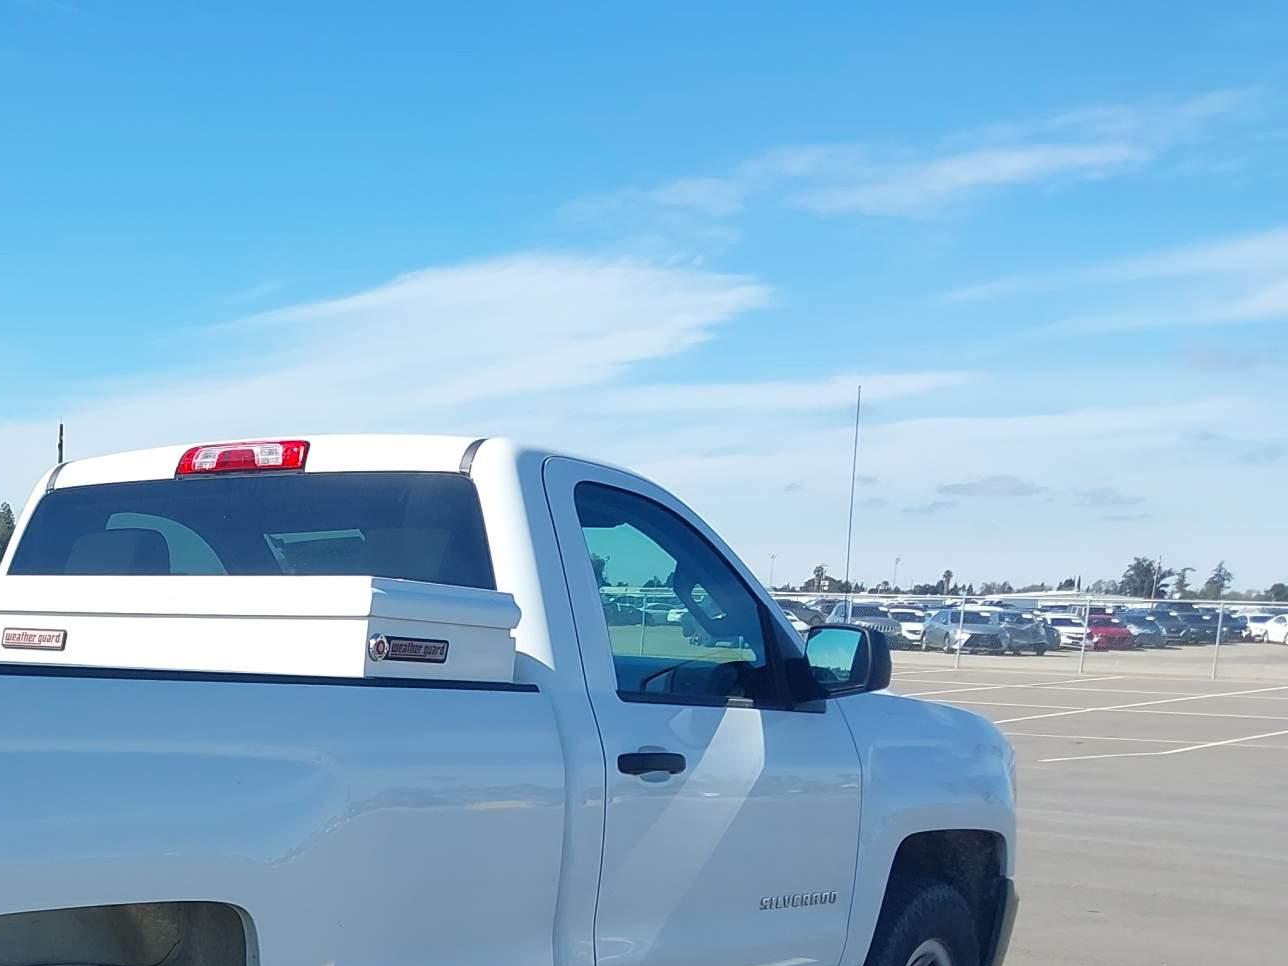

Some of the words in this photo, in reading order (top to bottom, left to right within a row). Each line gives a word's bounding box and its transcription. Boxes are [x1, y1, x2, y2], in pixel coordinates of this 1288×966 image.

[5, 632, 37, 643] weather
[37, 632, 62, 645] guard
[390, 641, 424, 654] weather
[423, 643, 446, 657] guard
[759, 890, 839, 911] SILVERADO
